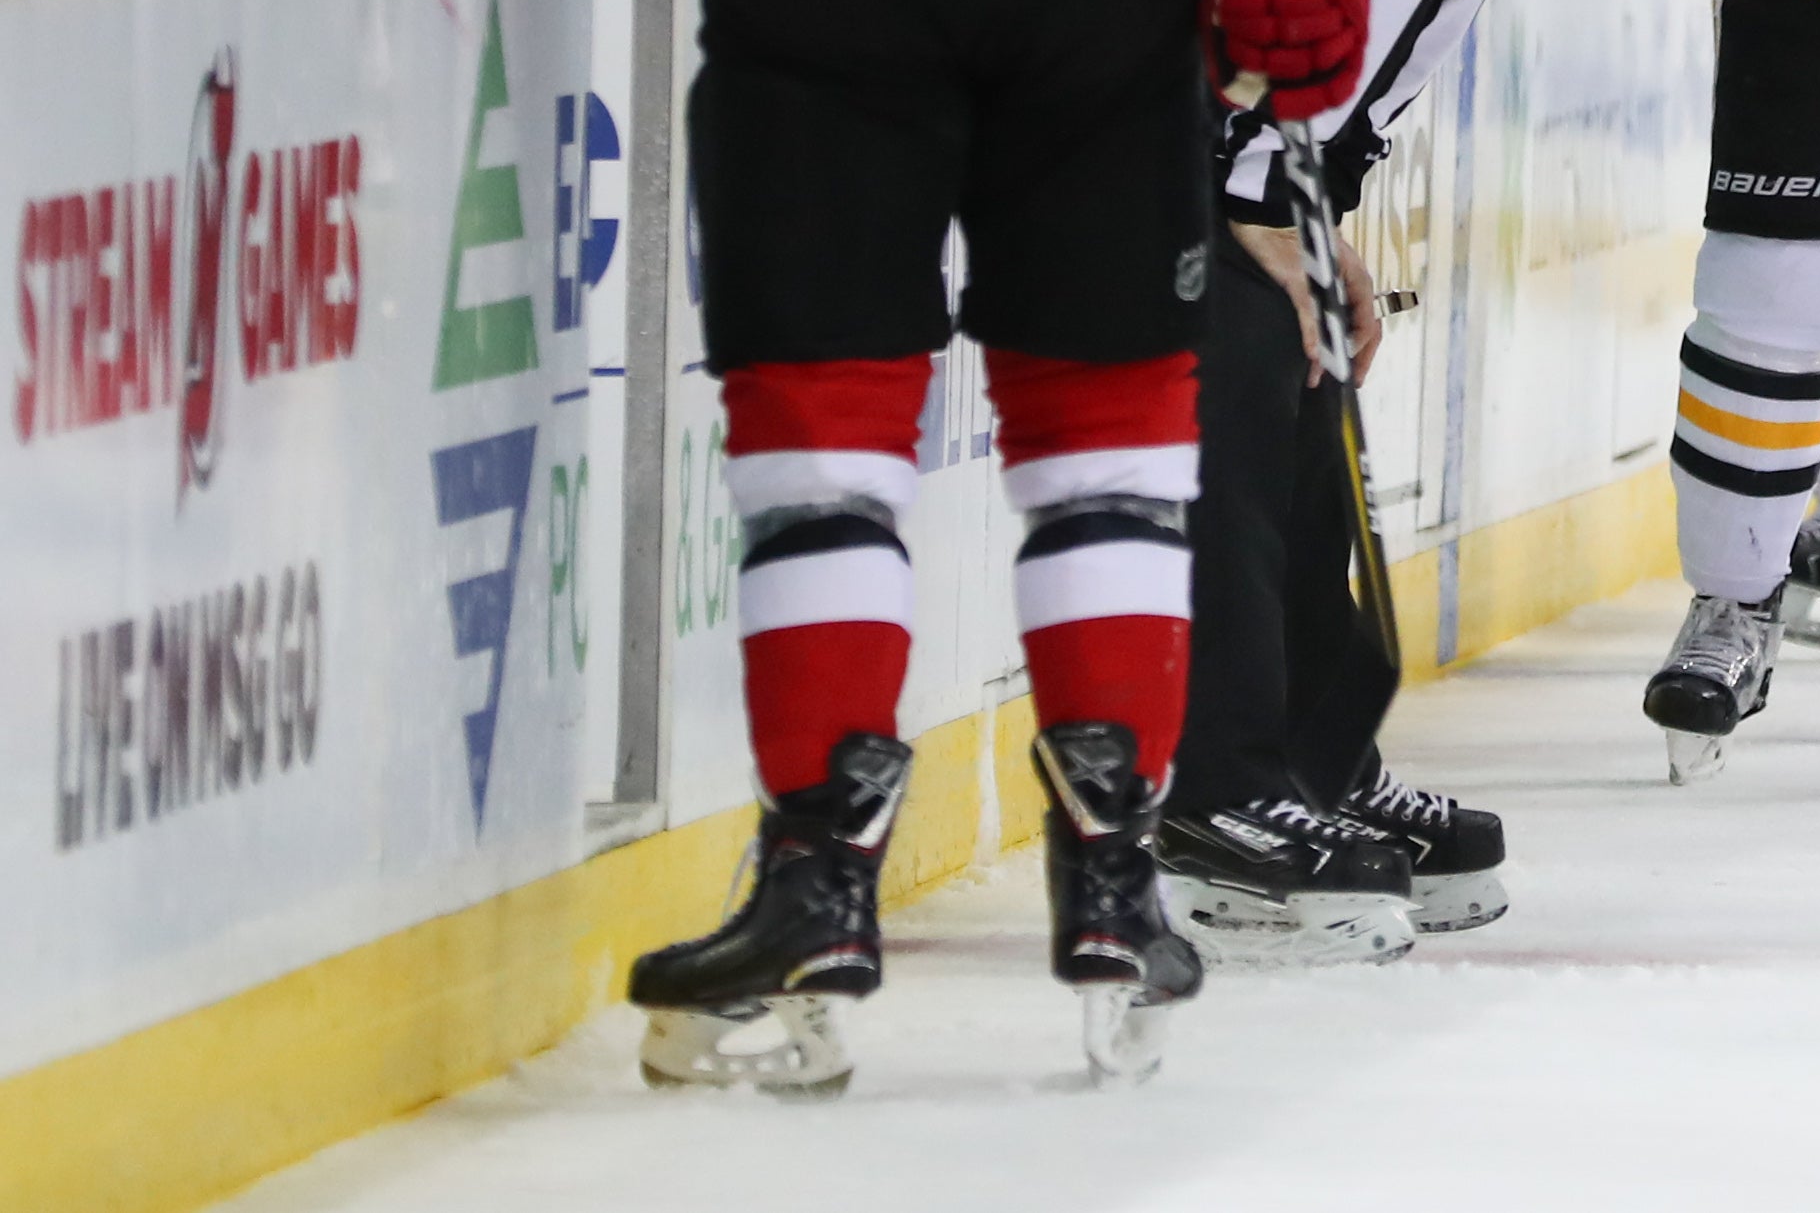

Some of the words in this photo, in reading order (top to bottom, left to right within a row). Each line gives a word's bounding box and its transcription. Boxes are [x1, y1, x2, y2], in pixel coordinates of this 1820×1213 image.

[14, 175, 176, 447] STREAM
[238, 133, 362, 384] GAMES
[55, 617, 134, 854] LIVE
[145, 597, 191, 823] ON
[199, 573, 268, 802] MSG
[275, 560, 320, 774] GO
